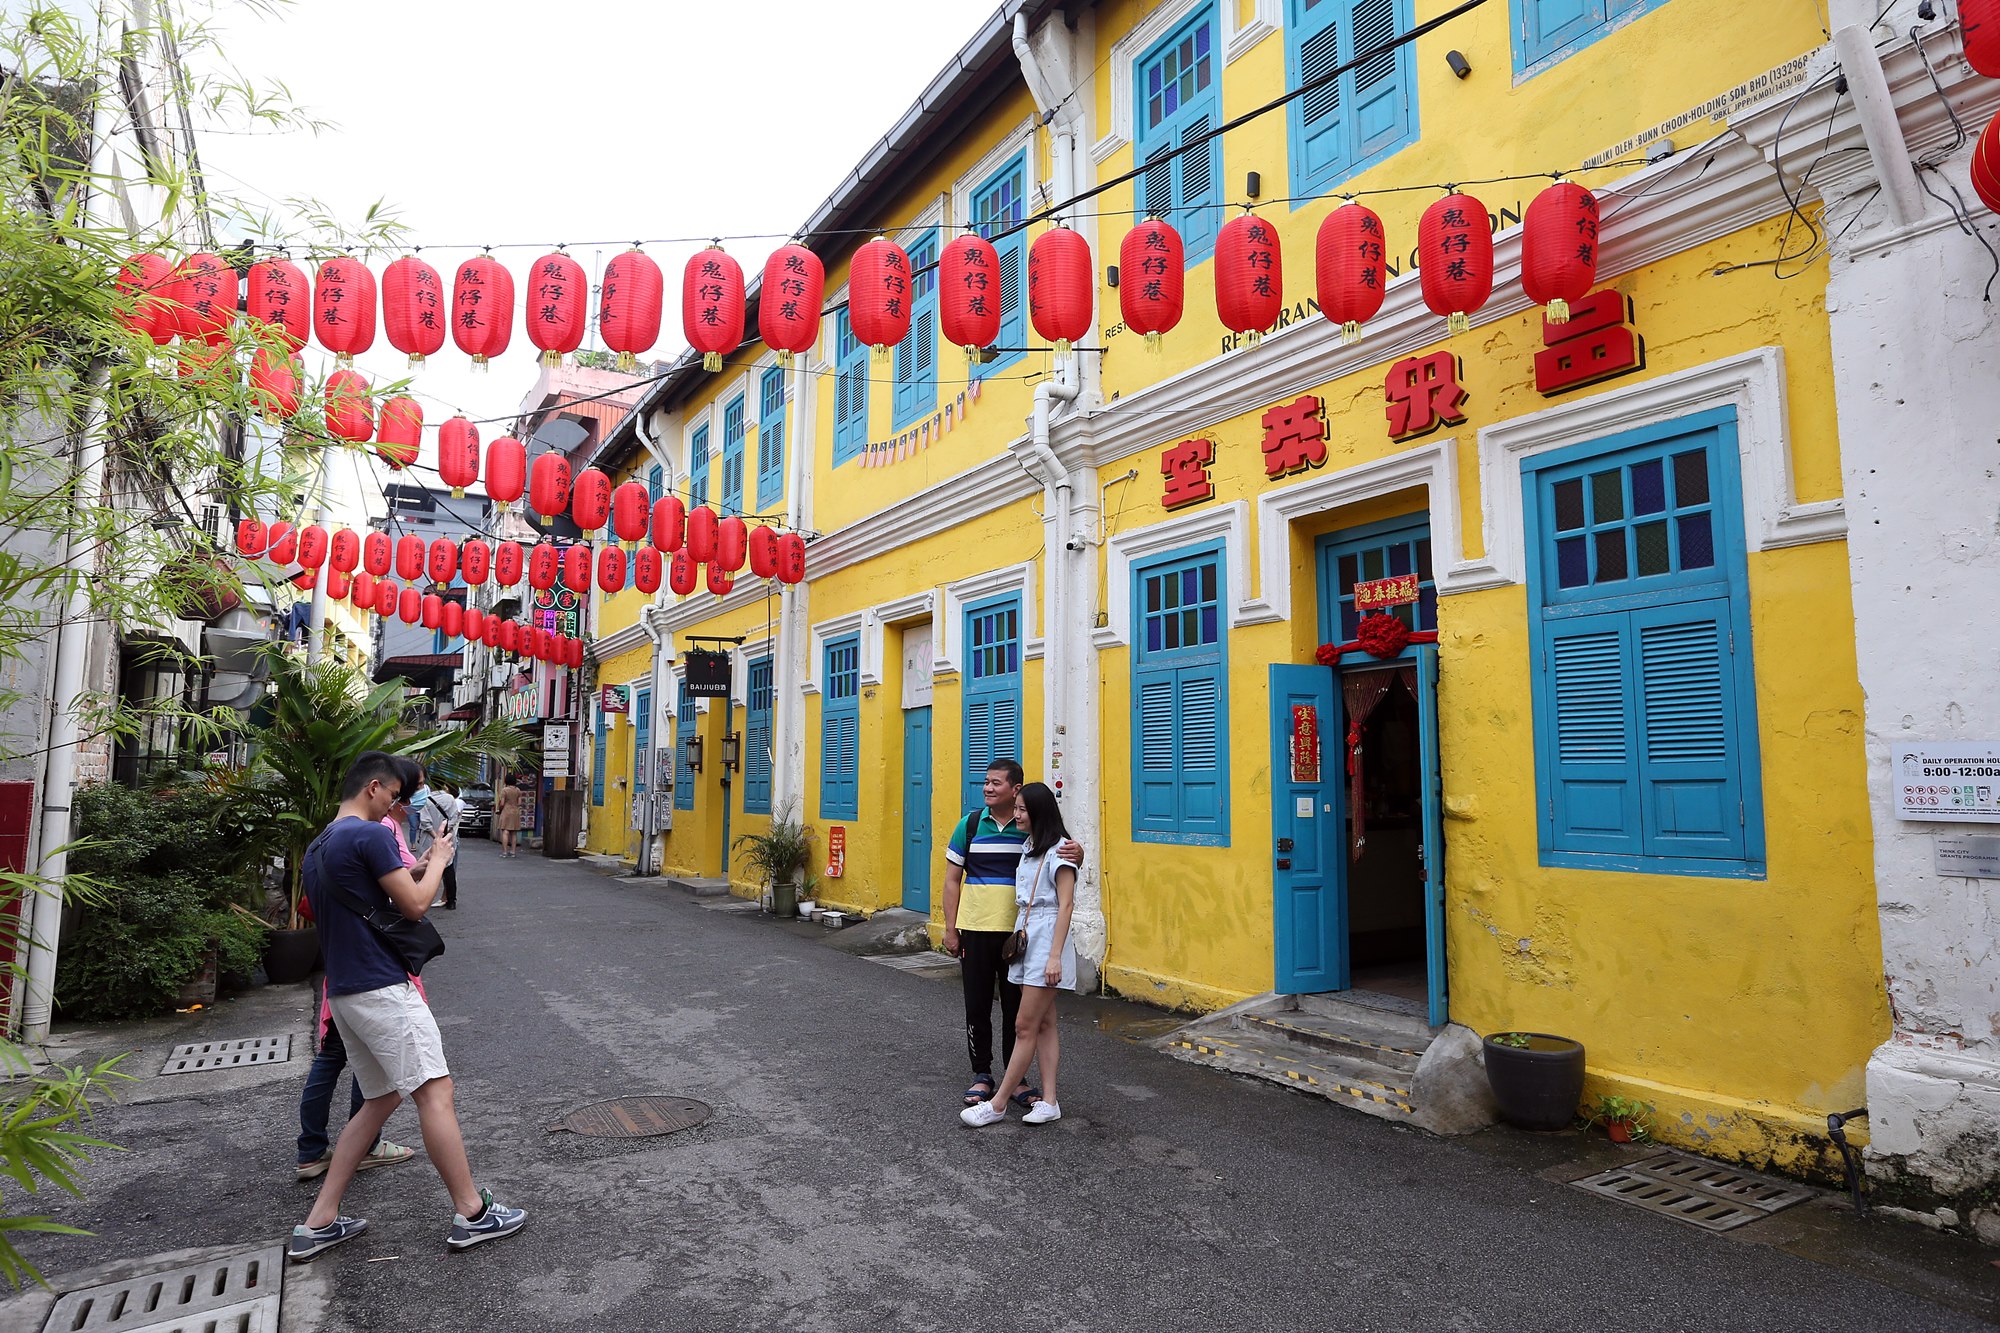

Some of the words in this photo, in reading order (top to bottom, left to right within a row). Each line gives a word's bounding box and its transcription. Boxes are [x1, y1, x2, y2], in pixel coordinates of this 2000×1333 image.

[1615, 139, 1633, 156] OLEH
[1729, 85, 1747, 102] SDN
[1749, 75, 1767, 93] BHD
[1247, 225, 1277, 297] 鬼仔巷
[1358, 215, 1383, 290] 鬼仔巷
[1440, 208, 1476, 281] 鬼仔巷
[1575, 193, 1597, 268] 鬼仔巷
[321, 266, 347, 326] 鬼仔巷
[539, 262, 566, 324] 鬼仔巷
[699, 260, 726, 326] 鬼仔巷
[778, 255, 808, 321] 鬼仔巷
[883, 250, 906, 319] 鬼仔巷
[963, 248, 992, 317] 鬼仔巷
[1141, 230, 1171, 302] 鬼仔巷
[415, 269, 440, 330] 鬼仔巷
[459, 267, 485, 329] 鬼仔巷
[556, 462, 568, 503] 鬼仔巷
[595, 478, 609, 518] 鬼仔巷
[606, 553, 619, 582] 鬼仔巷
[639, 554, 652, 584] 鬼仔巷
[711, 564, 724, 584] 仔巷
[791, 541, 801, 574] 鬼仔巷
[1359, 579, 1414, 604] 迎春接福
[1297, 708, 1313, 764] 生意興隆
